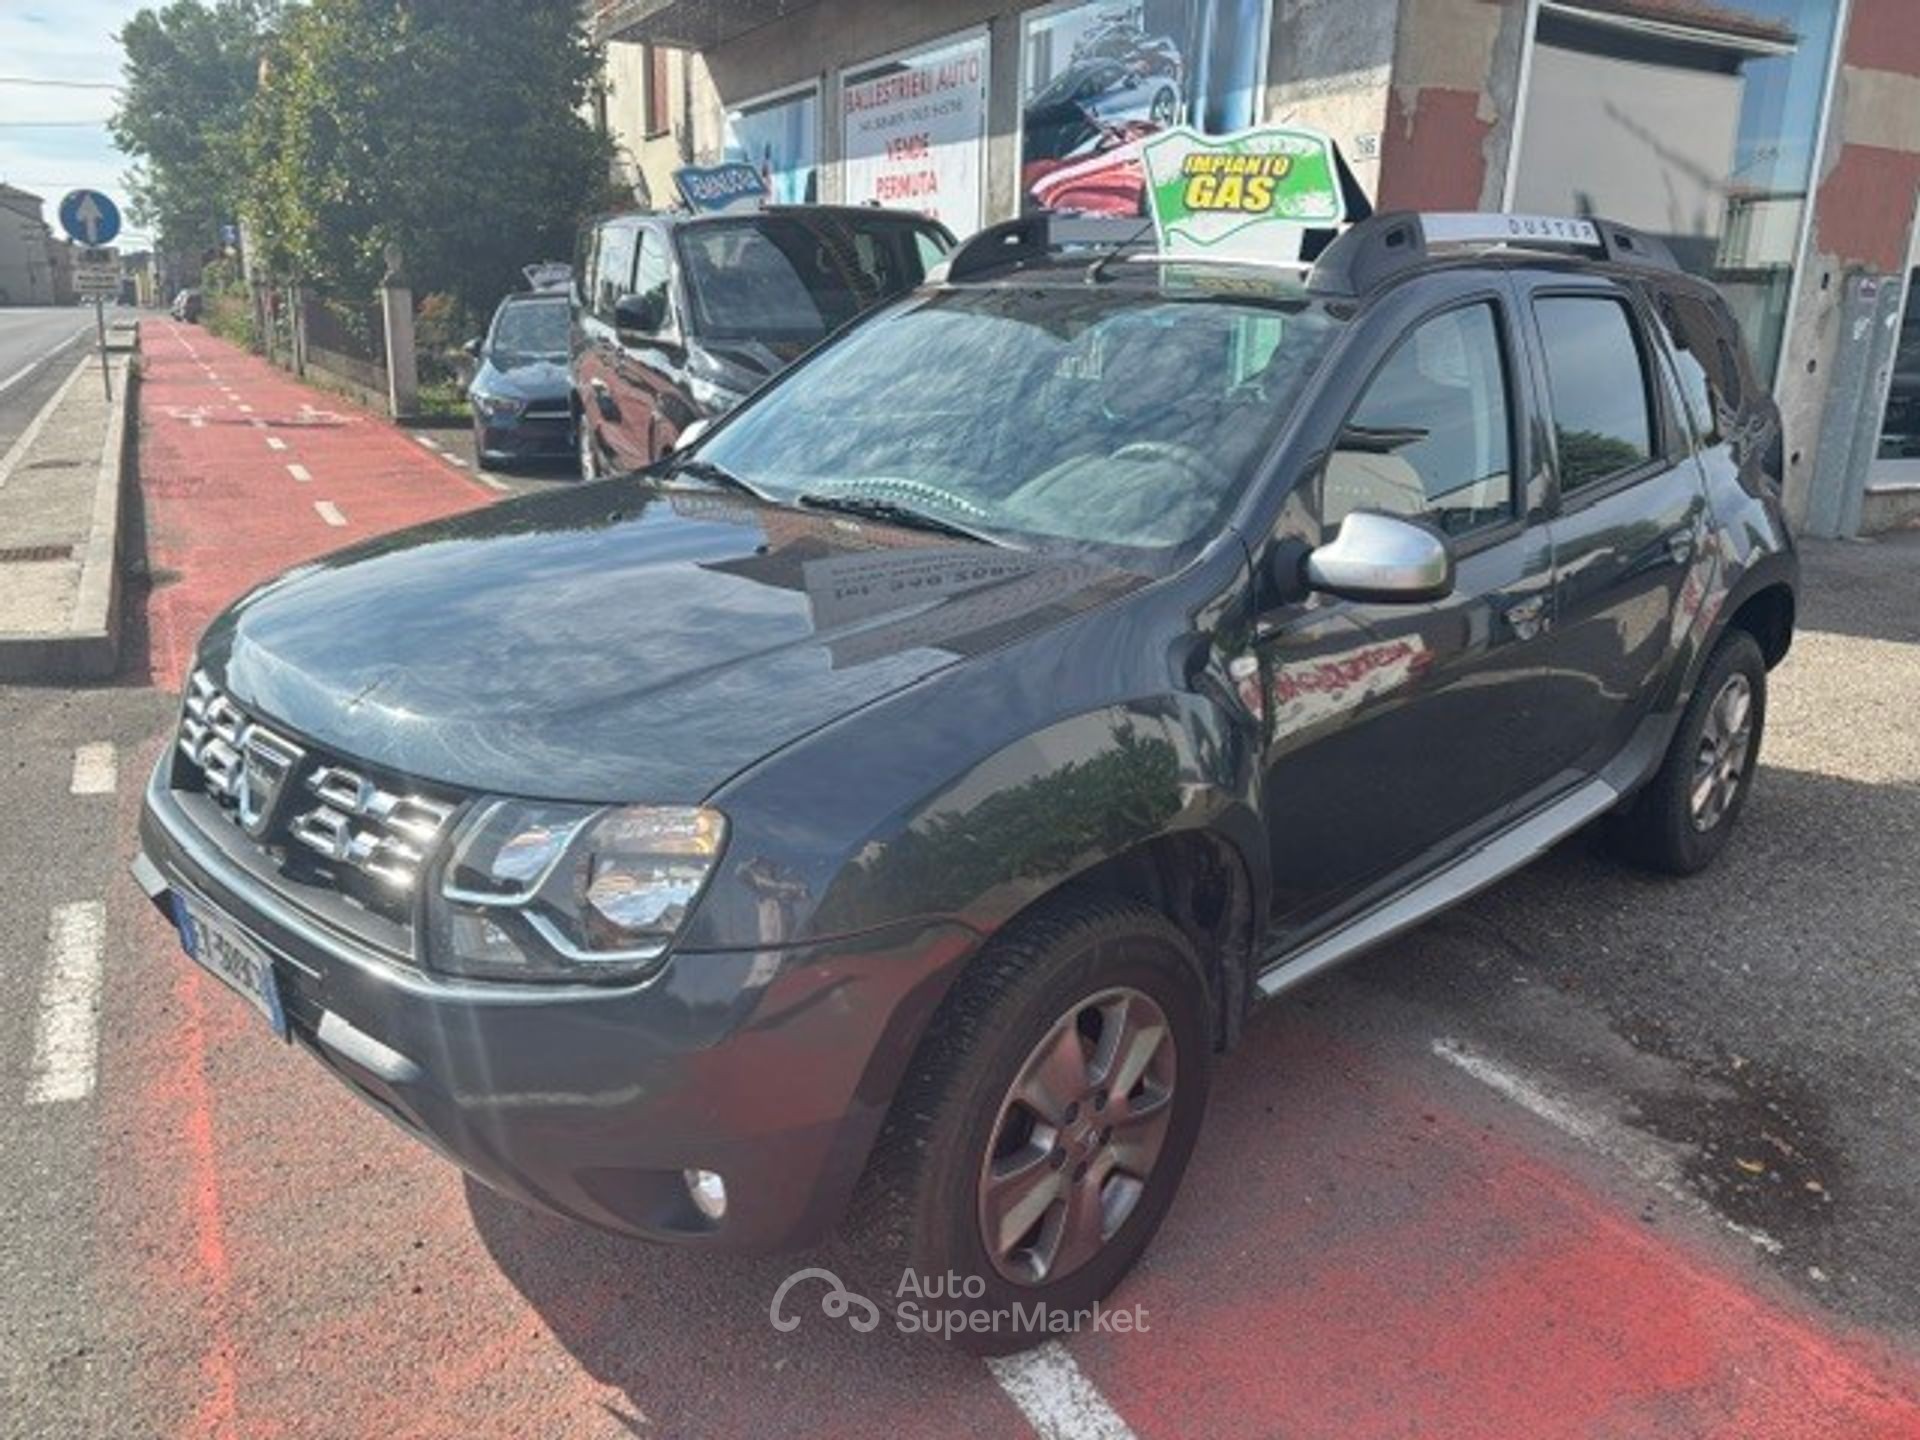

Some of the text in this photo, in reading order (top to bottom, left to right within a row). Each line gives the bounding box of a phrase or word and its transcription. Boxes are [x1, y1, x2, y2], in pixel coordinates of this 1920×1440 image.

[936, 55, 978, 91] AUTO
[886, 132, 929, 160] VENDE
[1184, 153, 1291, 177] IMPIANTO
[876, 169, 938, 200] PERMUTA
[1185, 174, 1276, 212] GAS
[1508, 218, 1594, 238] DUSTER
